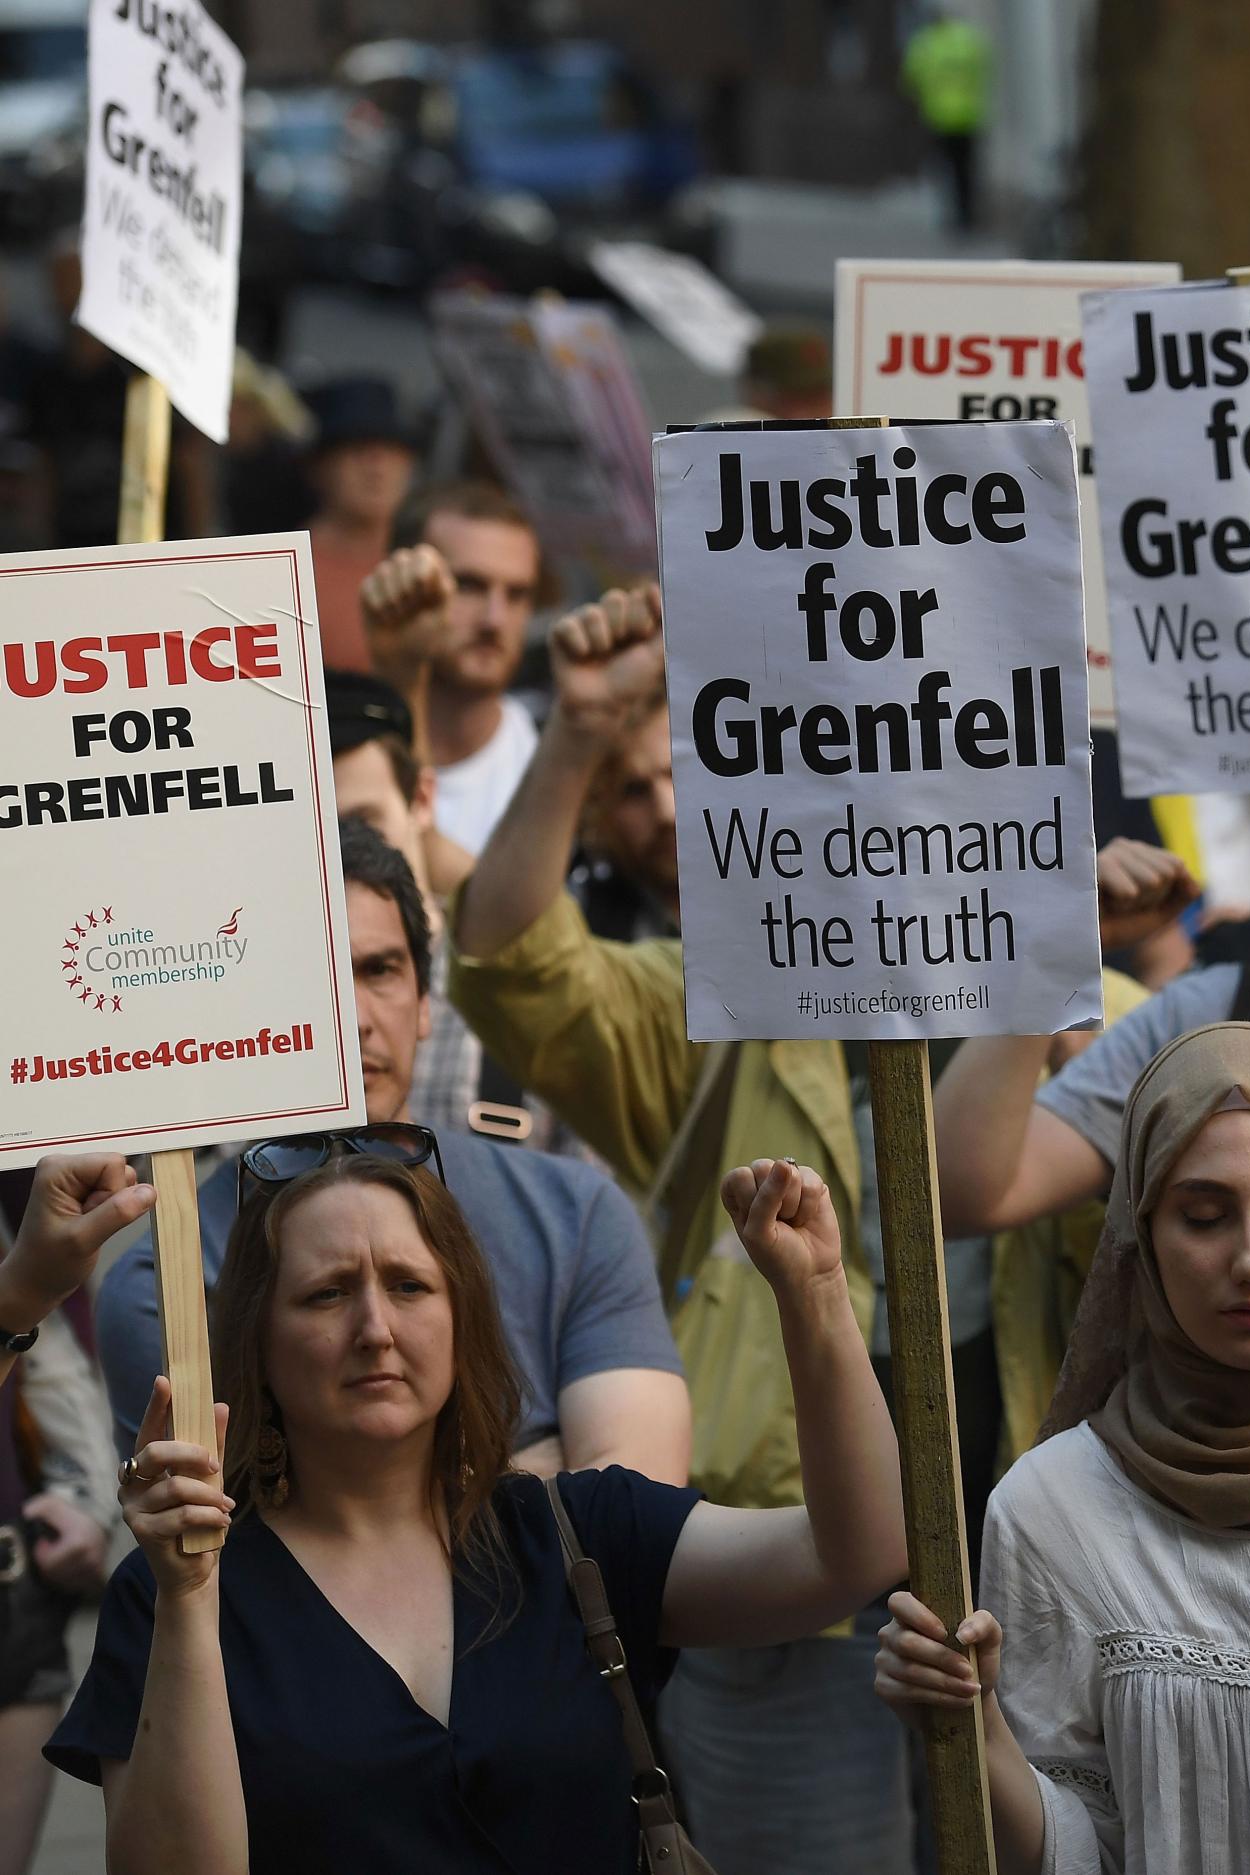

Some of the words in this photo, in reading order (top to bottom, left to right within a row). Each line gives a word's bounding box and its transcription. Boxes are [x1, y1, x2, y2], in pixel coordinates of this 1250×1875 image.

[102, 100, 226, 256] Grenfell
[878, 333, 1086, 380] JUSTIC
[959, 392, 1059, 421] FOR
[705, 446, 1027, 552] Justice
[797, 562, 939, 662] for
[1134, 602, 1219, 665] We
[3, 624, 282, 698] USTICE
[72, 706, 195, 758] FOR
[692, 666, 1066, 777] Grenfell
[0, 762, 294, 829] GRENFELL
[703, 807, 803, 880] We
[822, 796, 1064, 878] demand
[85, 936, 248, 973] Community
[107, 928, 154, 947] unite
[760, 894, 854, 969] the
[870, 887, 1016, 967] truth
[111, 962, 225, 989] membership
[797, 984, 990, 1019] #justiceforgrenfell
[10, 1023, 314, 1084] #Justice4Grenfell
